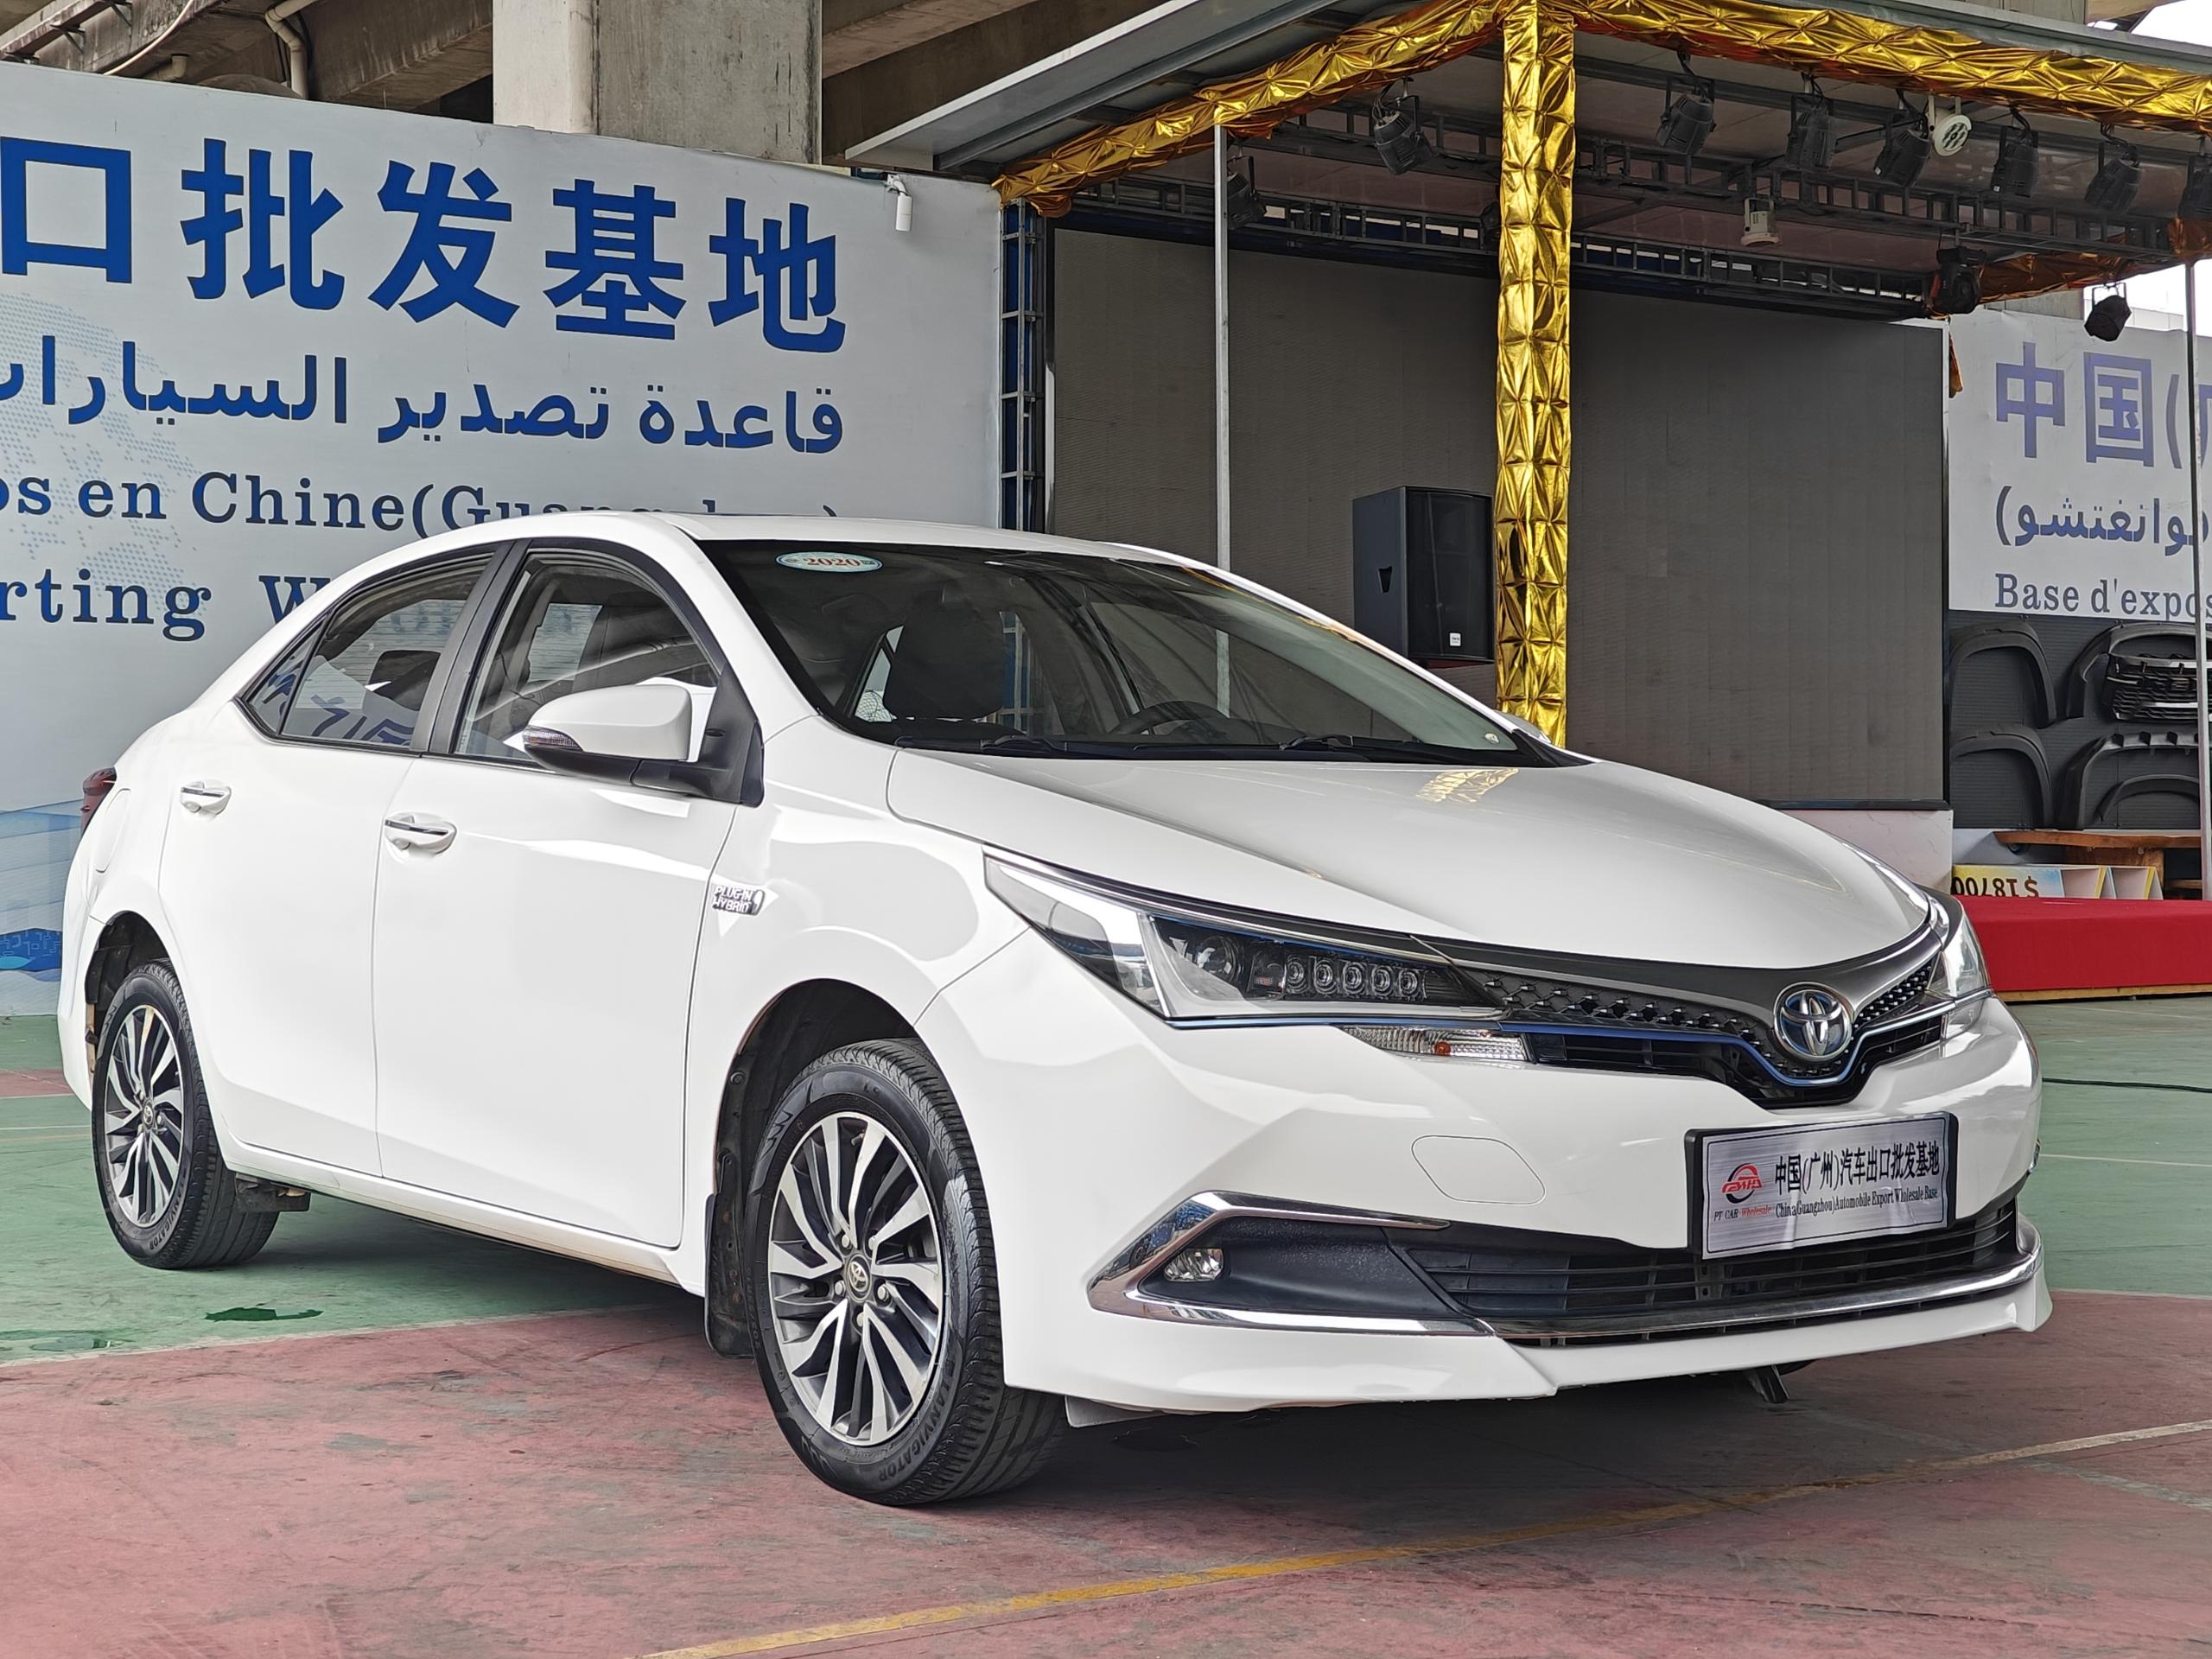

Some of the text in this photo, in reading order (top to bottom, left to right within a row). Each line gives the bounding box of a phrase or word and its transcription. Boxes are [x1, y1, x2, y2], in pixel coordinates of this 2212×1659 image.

[0, 137, 847, 353] 口批发基地
[378, 382, 609, 444] تصدير
[638, 384, 843, 454] قاعدة
[1996, 340, 2212, 469] 中国(
[78, 480, 167, 520] en
[803, 557, 861, 567] 2020
[1995, 573, 2080, 612] Base
[1775, 1141, 1940, 1196] 中国(广州)汽车出口批发基地
[1713, 1211, 1724, 1221] PT
[1724, 1208, 1739, 1220] CAR
[1872, 1191, 1894, 1208] Export
[1924, 1185, 1938, 1199] Base
